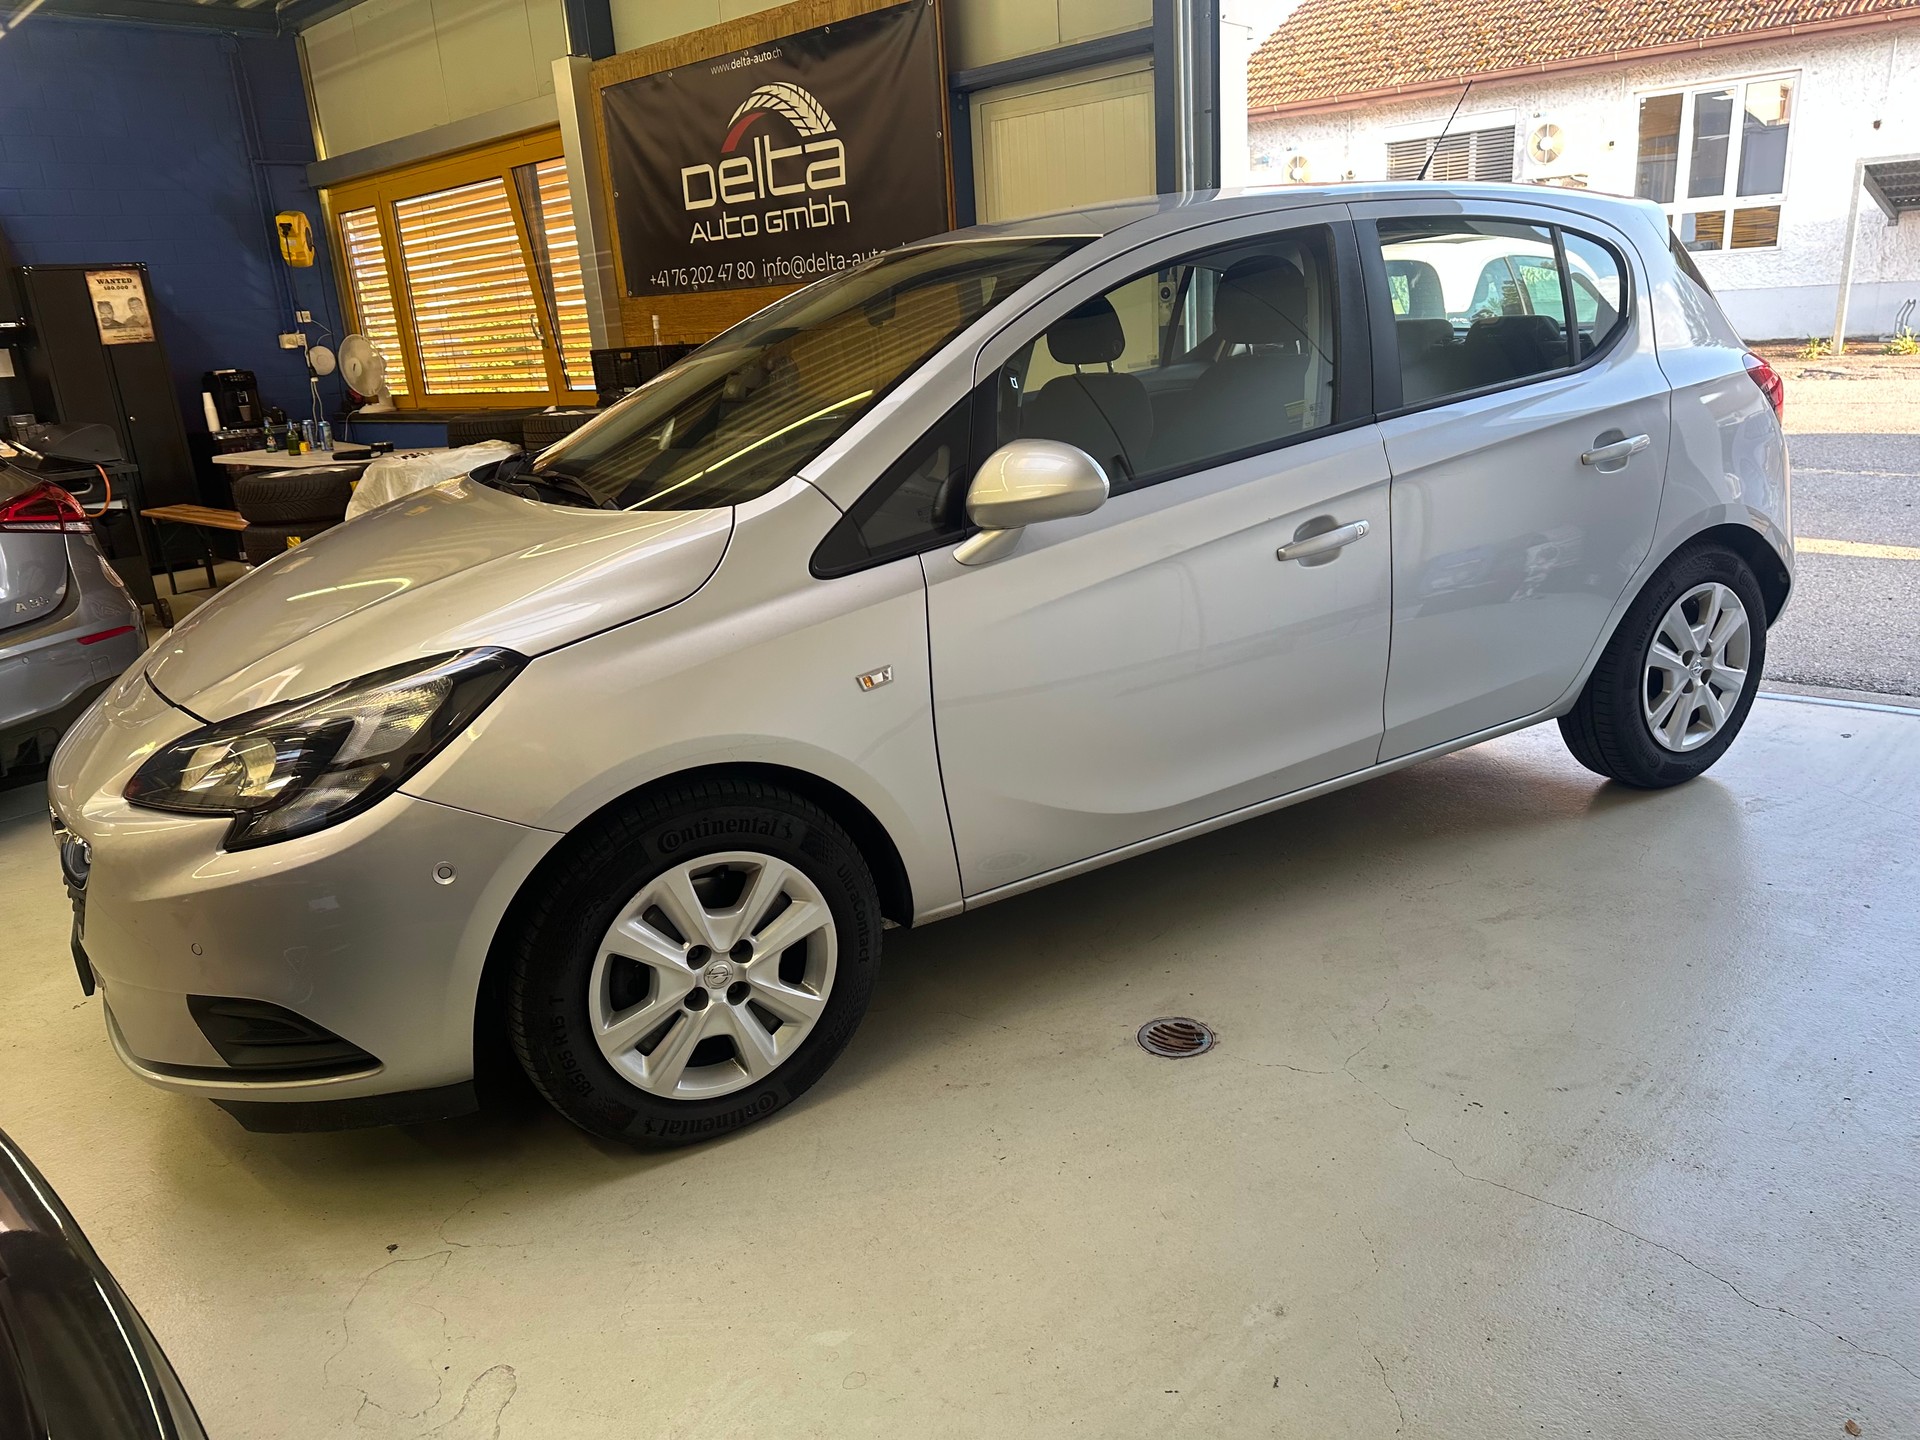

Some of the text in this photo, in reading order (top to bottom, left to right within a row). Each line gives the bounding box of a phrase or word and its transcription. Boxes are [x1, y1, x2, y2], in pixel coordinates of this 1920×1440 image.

[710, 46, 783, 75] www.delta-auto.ch
[96, 276, 133, 285] WANTED
[650, 242, 905, 287] +41 76 202 47 80 info@delta-aut
[657, 817, 779, 854] Continental
[836, 862, 870, 964] UltraContact
[558, 1049, 595, 1098] 185/65
[658, 1089, 780, 1137] Continental
